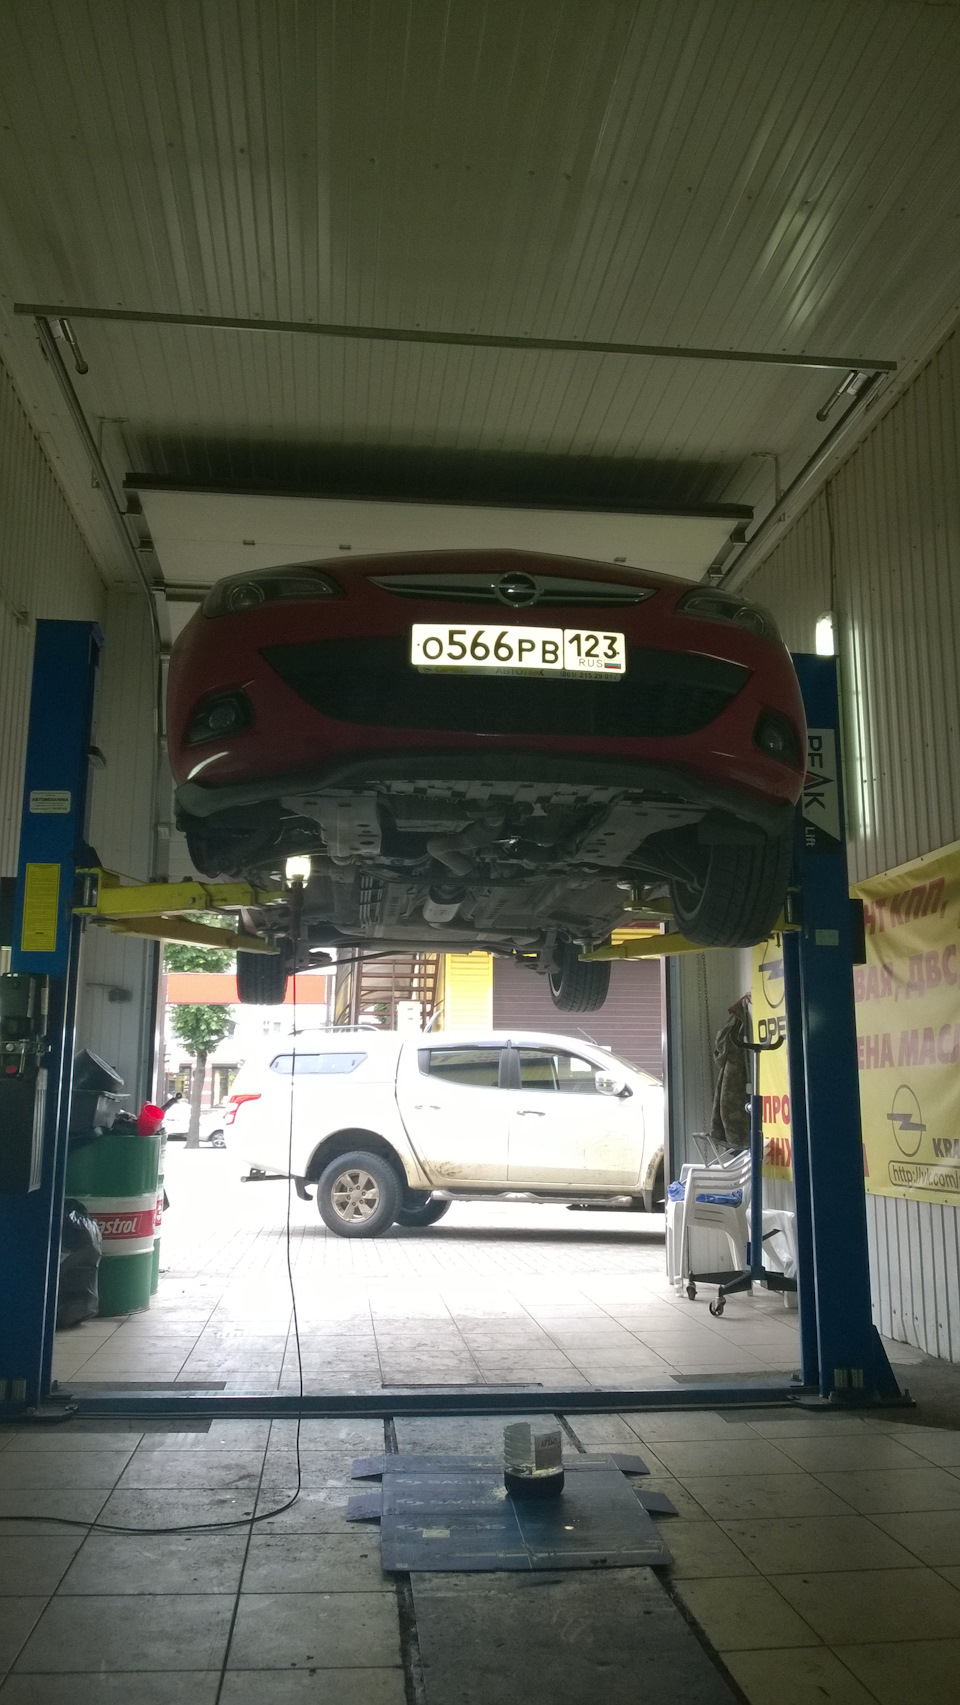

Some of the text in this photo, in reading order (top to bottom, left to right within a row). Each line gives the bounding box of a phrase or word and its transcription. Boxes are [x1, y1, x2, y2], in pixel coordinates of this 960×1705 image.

[567, 633, 620, 659] 123
[578, 658, 603, 668] RUS
[805, 826, 816, 847] Lift
[889, 876, 950, 928] КПП,
[853, 943, 960, 1002] ВАЯ, ДВС
[763, 1094, 791, 1125] ПРО
[93, 1217, 139, 1235] astrol
